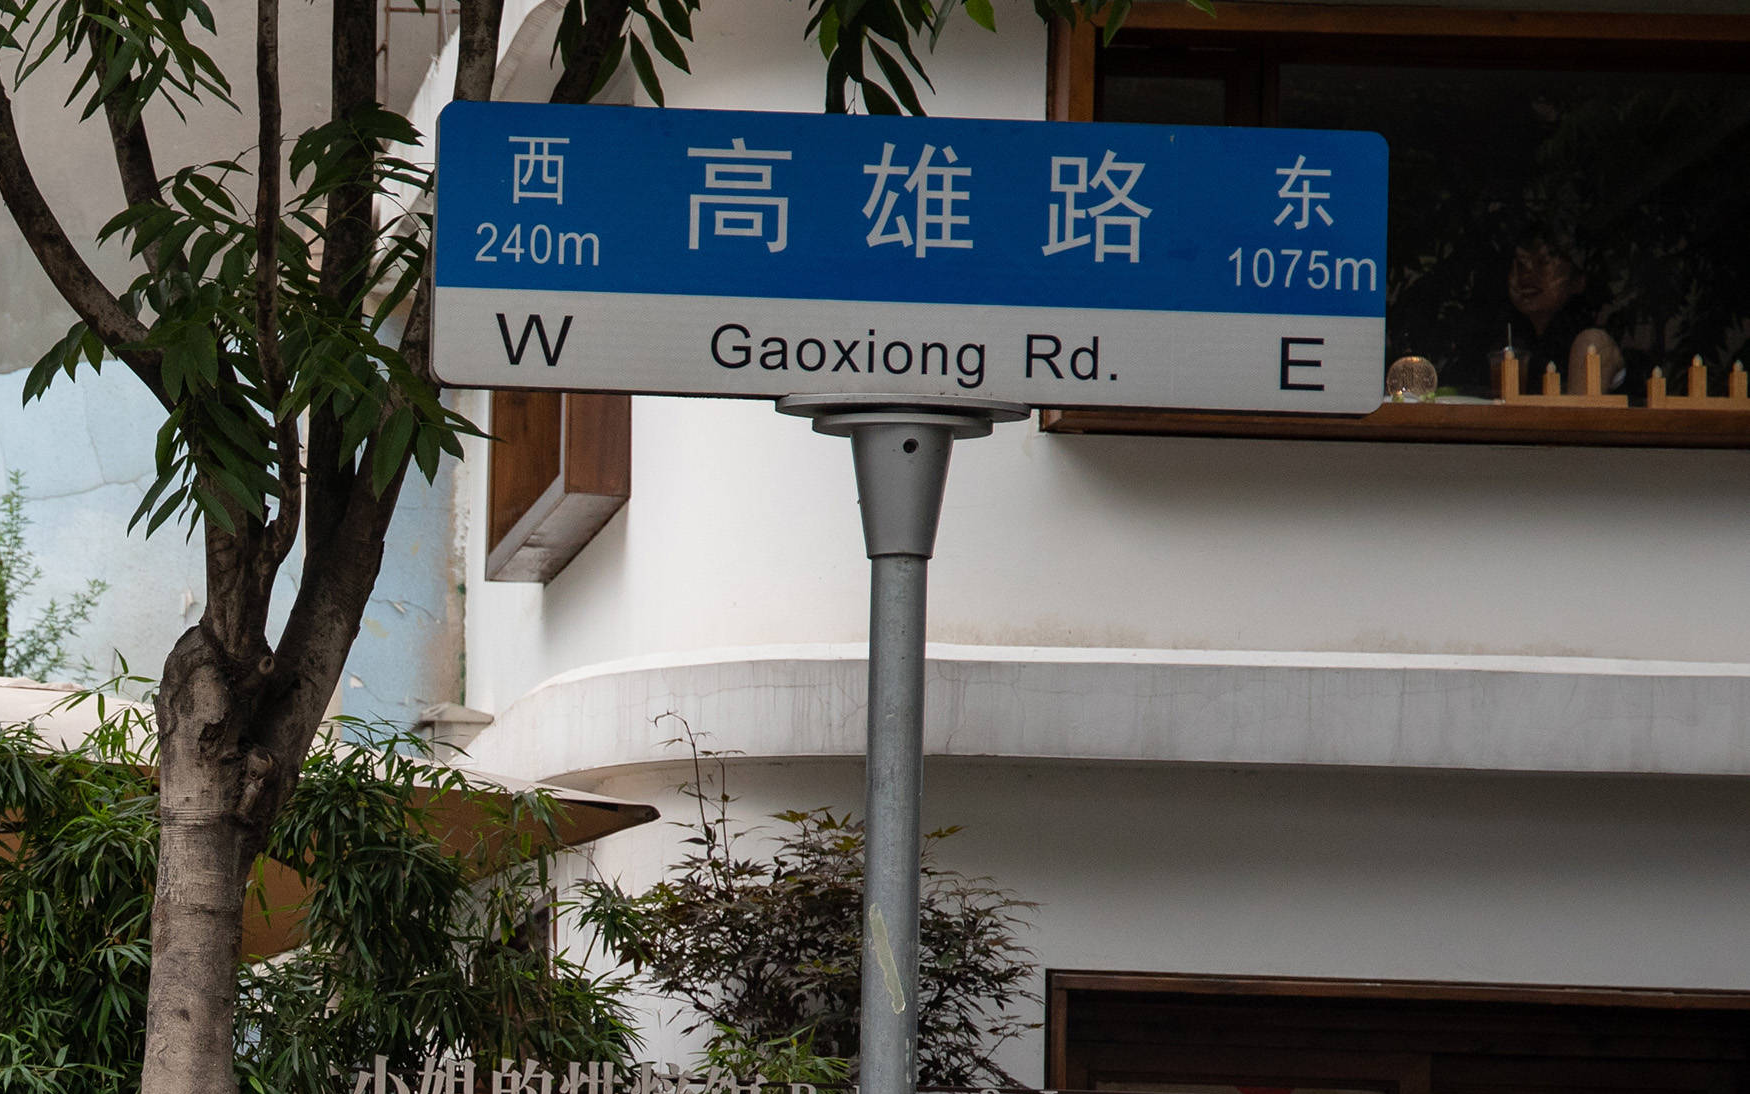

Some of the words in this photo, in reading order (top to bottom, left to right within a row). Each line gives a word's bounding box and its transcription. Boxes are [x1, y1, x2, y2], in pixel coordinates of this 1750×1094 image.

[509, 136, 570, 205] 西
[1274, 154, 1334, 230] 东
[687, 138, 1152, 264] 高雄路
[475, 223, 601, 266] 240m
[1227, 246, 1378, 292] 1075m
[496, 313, 573, 367] W
[711, 323, 987, 389] Gaoxiong
[1025, 334, 1119, 382] Rd.
[1280, 337, 1325, 391] E
